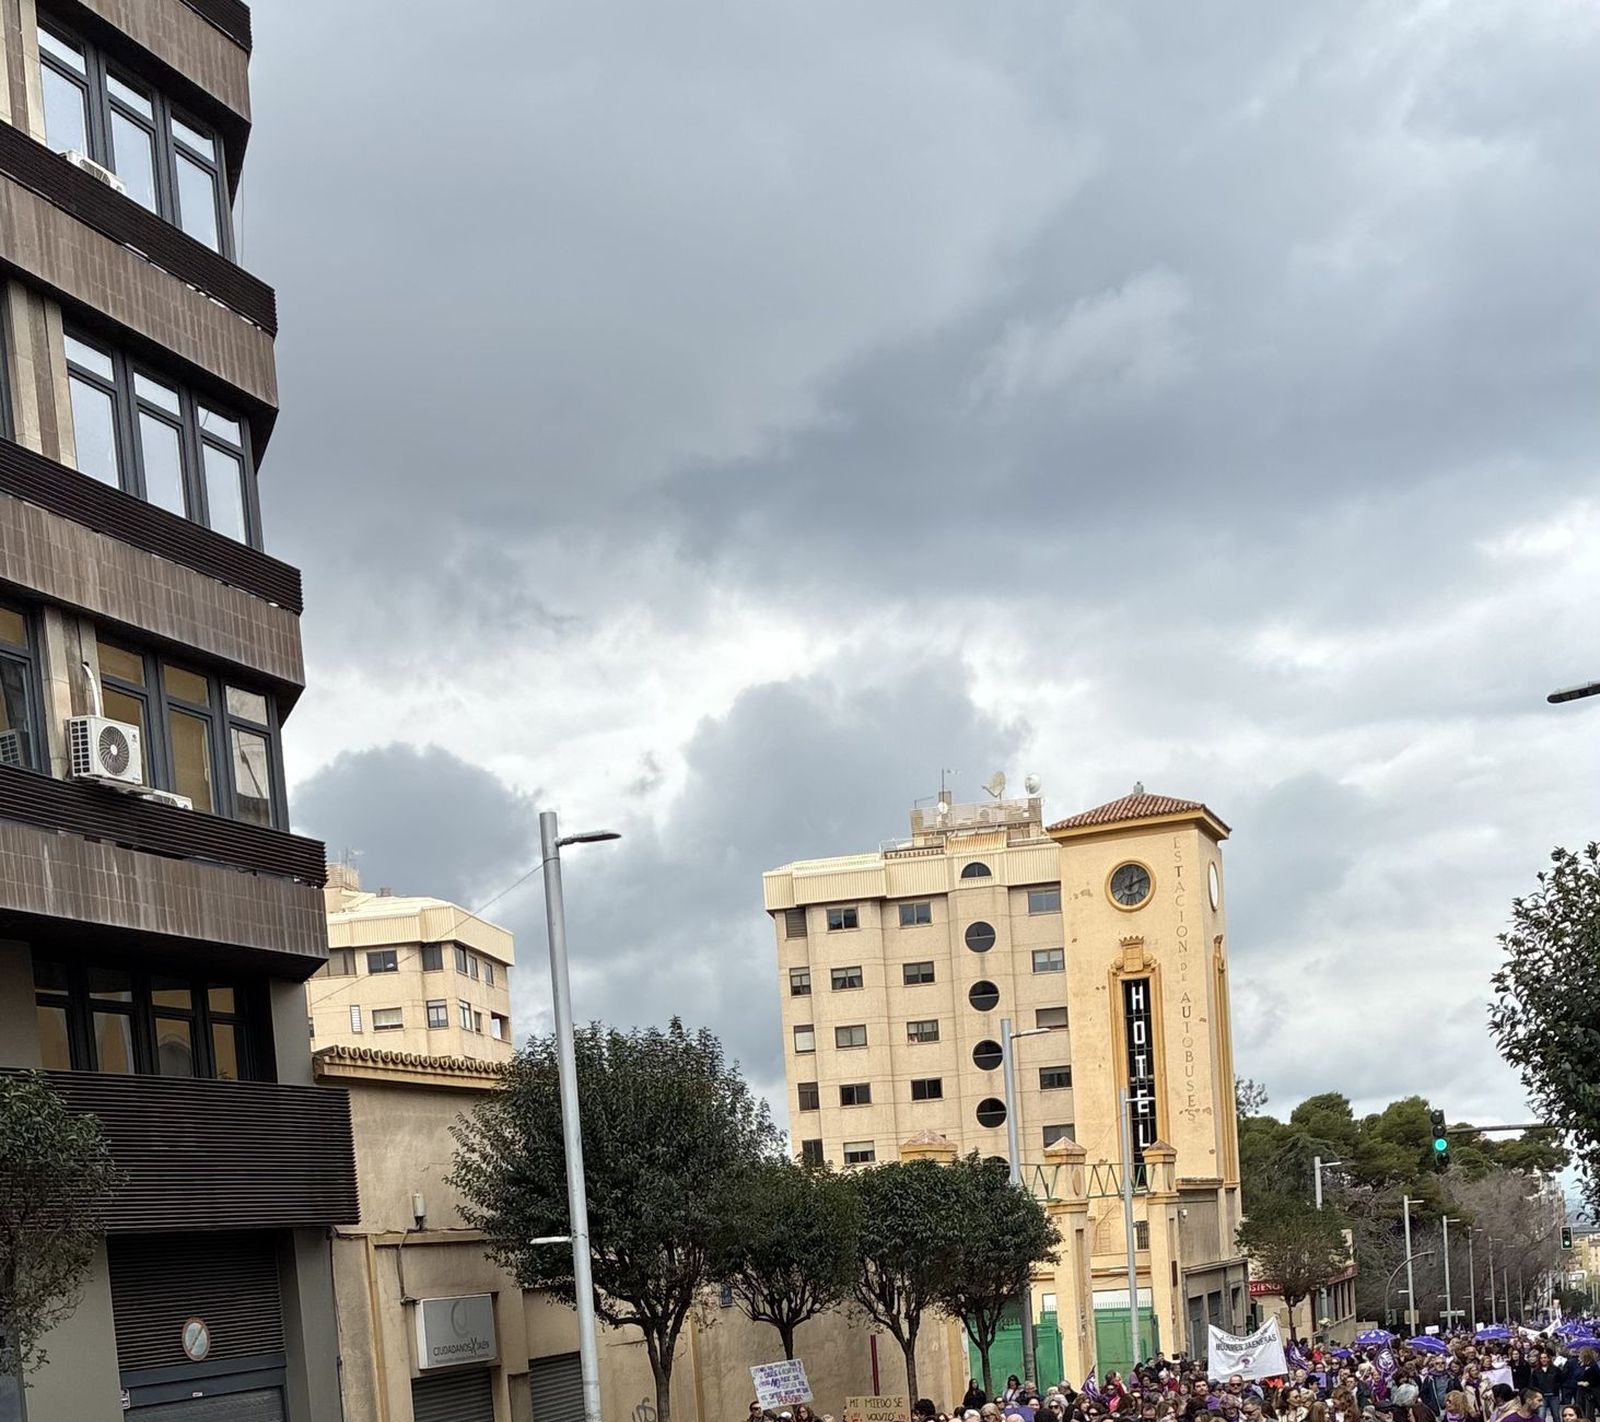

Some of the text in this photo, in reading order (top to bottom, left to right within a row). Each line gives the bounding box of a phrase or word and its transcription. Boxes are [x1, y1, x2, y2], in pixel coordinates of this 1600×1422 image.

[1172, 836, 1189, 954] ESTACION
[1131, 985, 1151, 1147] HOTEL
[1179, 991, 1197, 1122] AUTOBUSES
[849, 1397, 904, 1408] MI MIEDO SE
